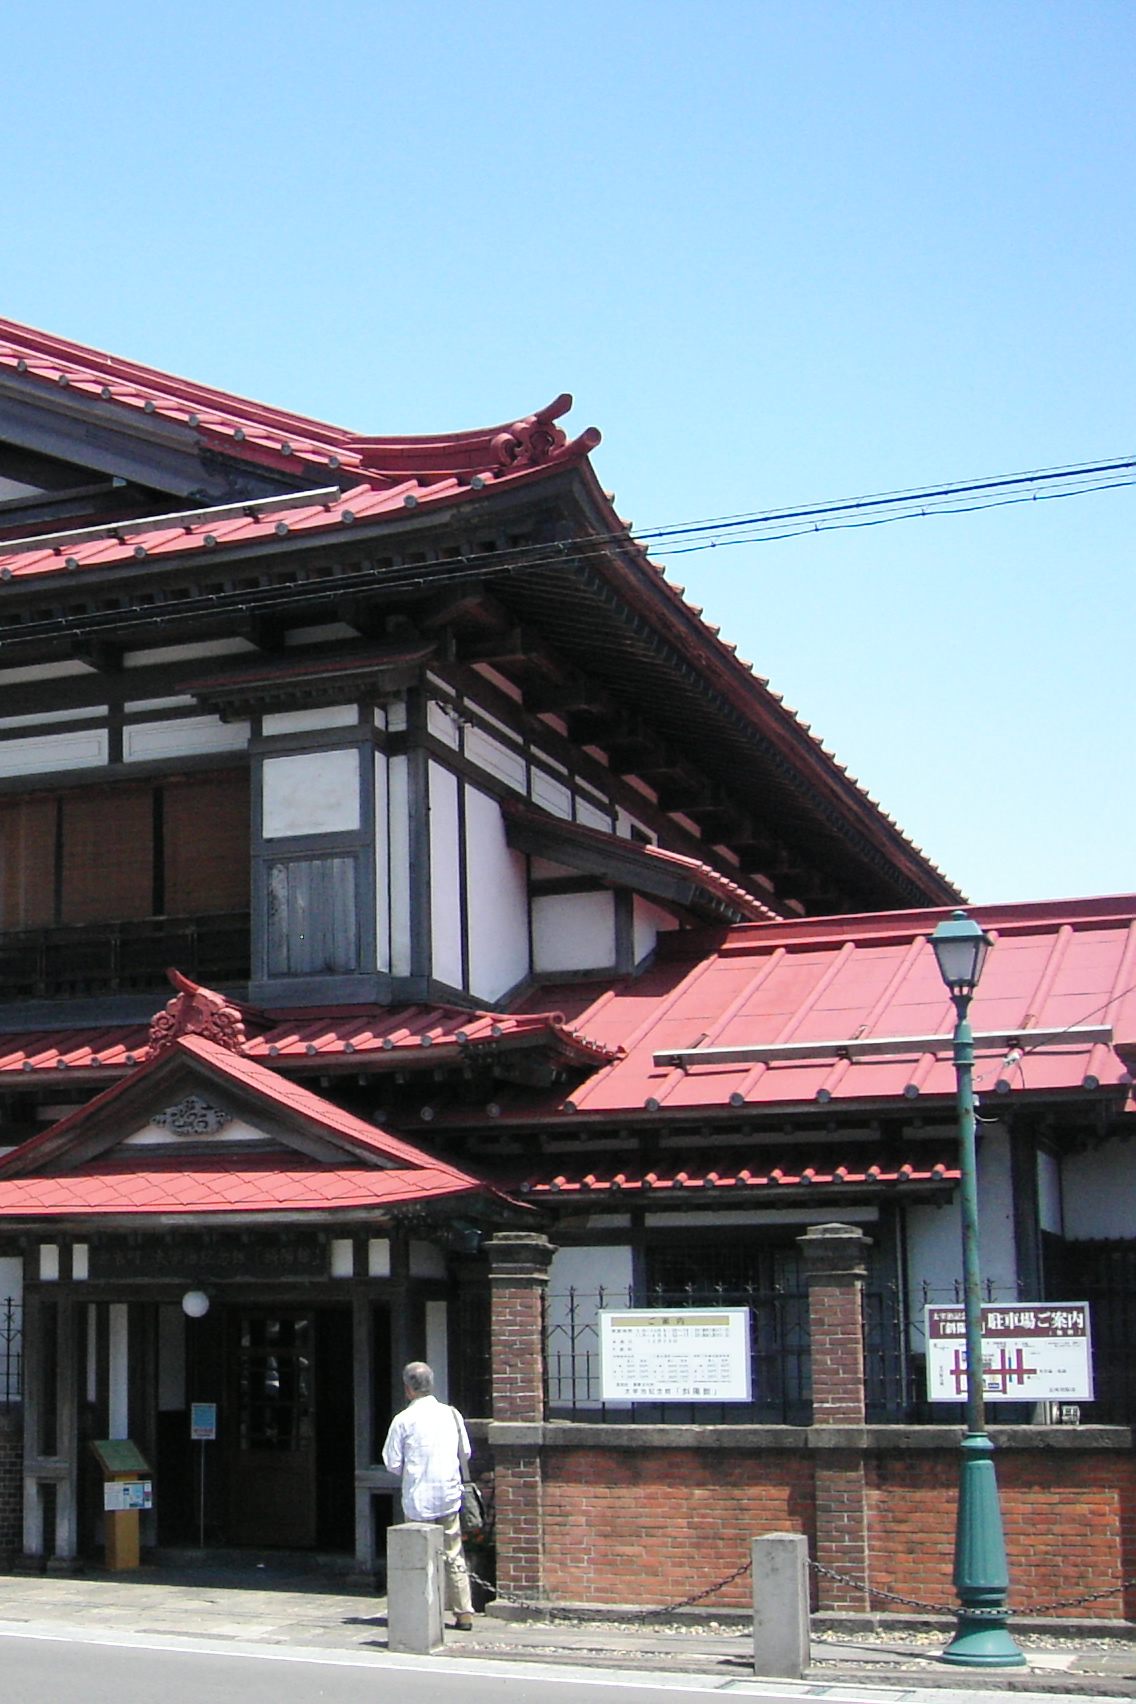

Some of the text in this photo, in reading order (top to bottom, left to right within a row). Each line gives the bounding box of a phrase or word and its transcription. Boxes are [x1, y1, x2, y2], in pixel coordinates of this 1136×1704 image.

[933, 1311, 966, 1320] 太宰治記念
[987, 1311, 1084, 1329] 駐車場ご案内
[939, 1322, 985, 1335] 「斜陽」
